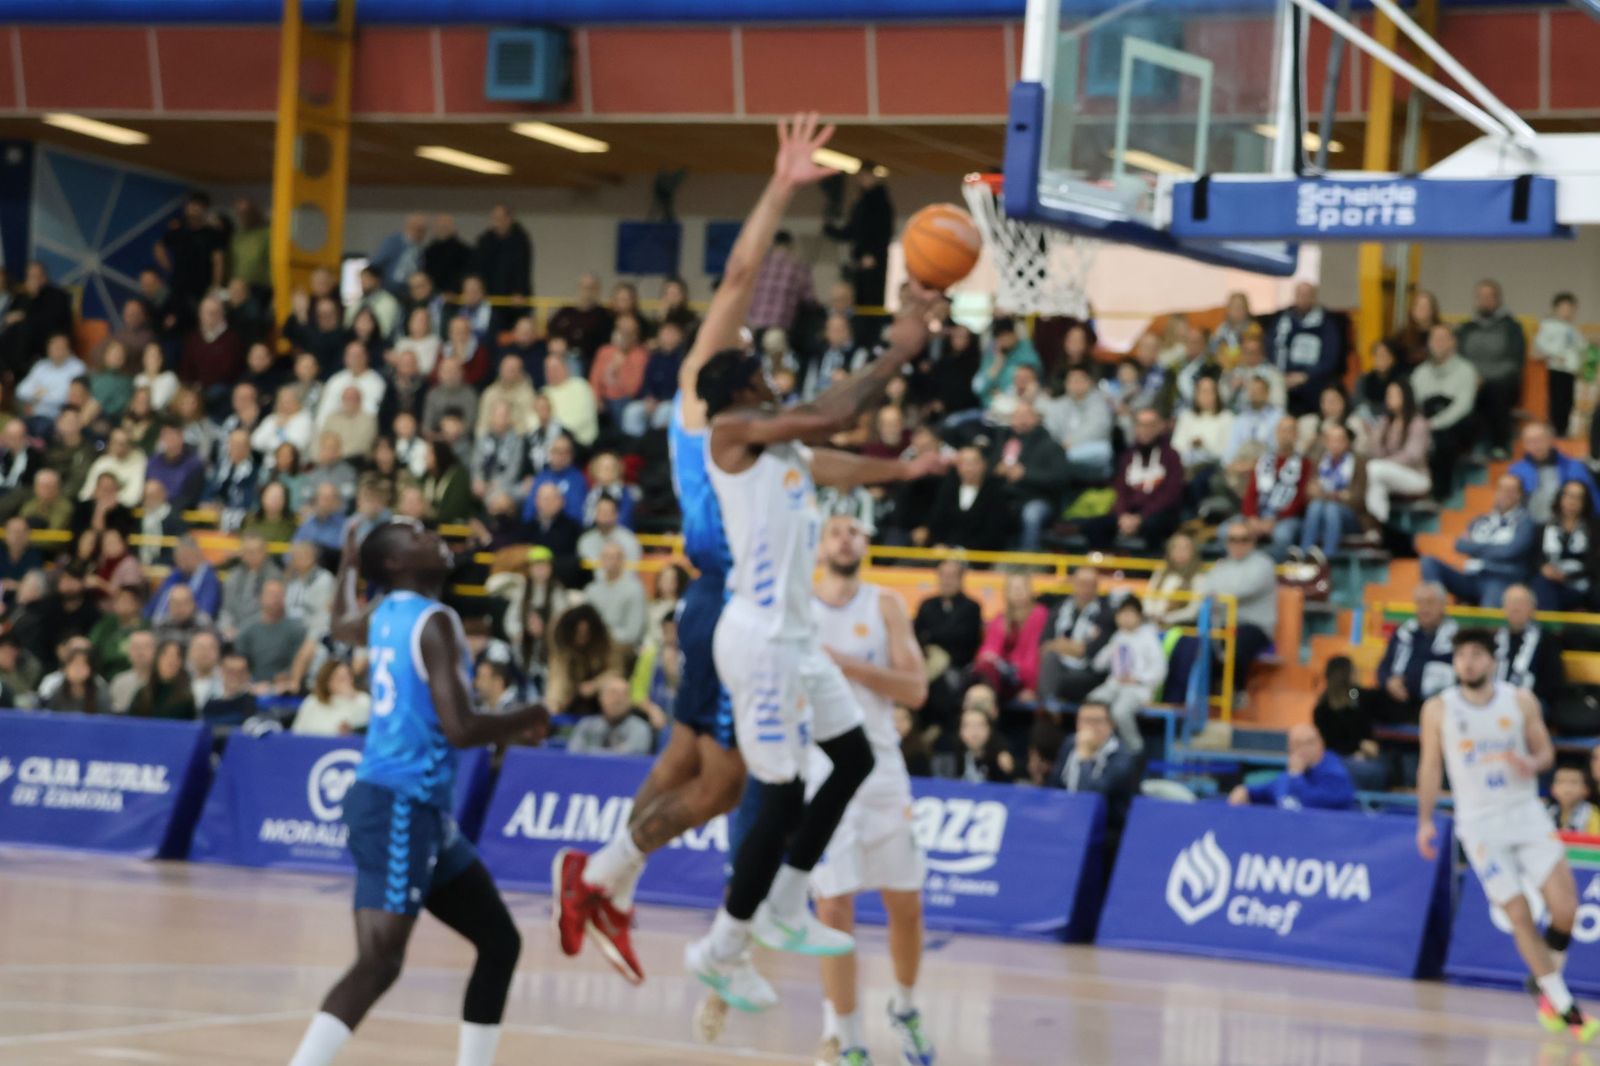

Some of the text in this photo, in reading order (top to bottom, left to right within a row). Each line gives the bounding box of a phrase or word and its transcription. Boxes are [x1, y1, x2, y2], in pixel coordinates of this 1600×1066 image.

[1297, 183, 1417, 206] Scheide
[1296, 206, 1417, 232] Sports
[18, 756, 170, 794] CAJA RURAL
[912, 796, 1008, 853] aza
[1234, 852, 1371, 902] INNOVA
[1227, 895, 1301, 936] Chef
